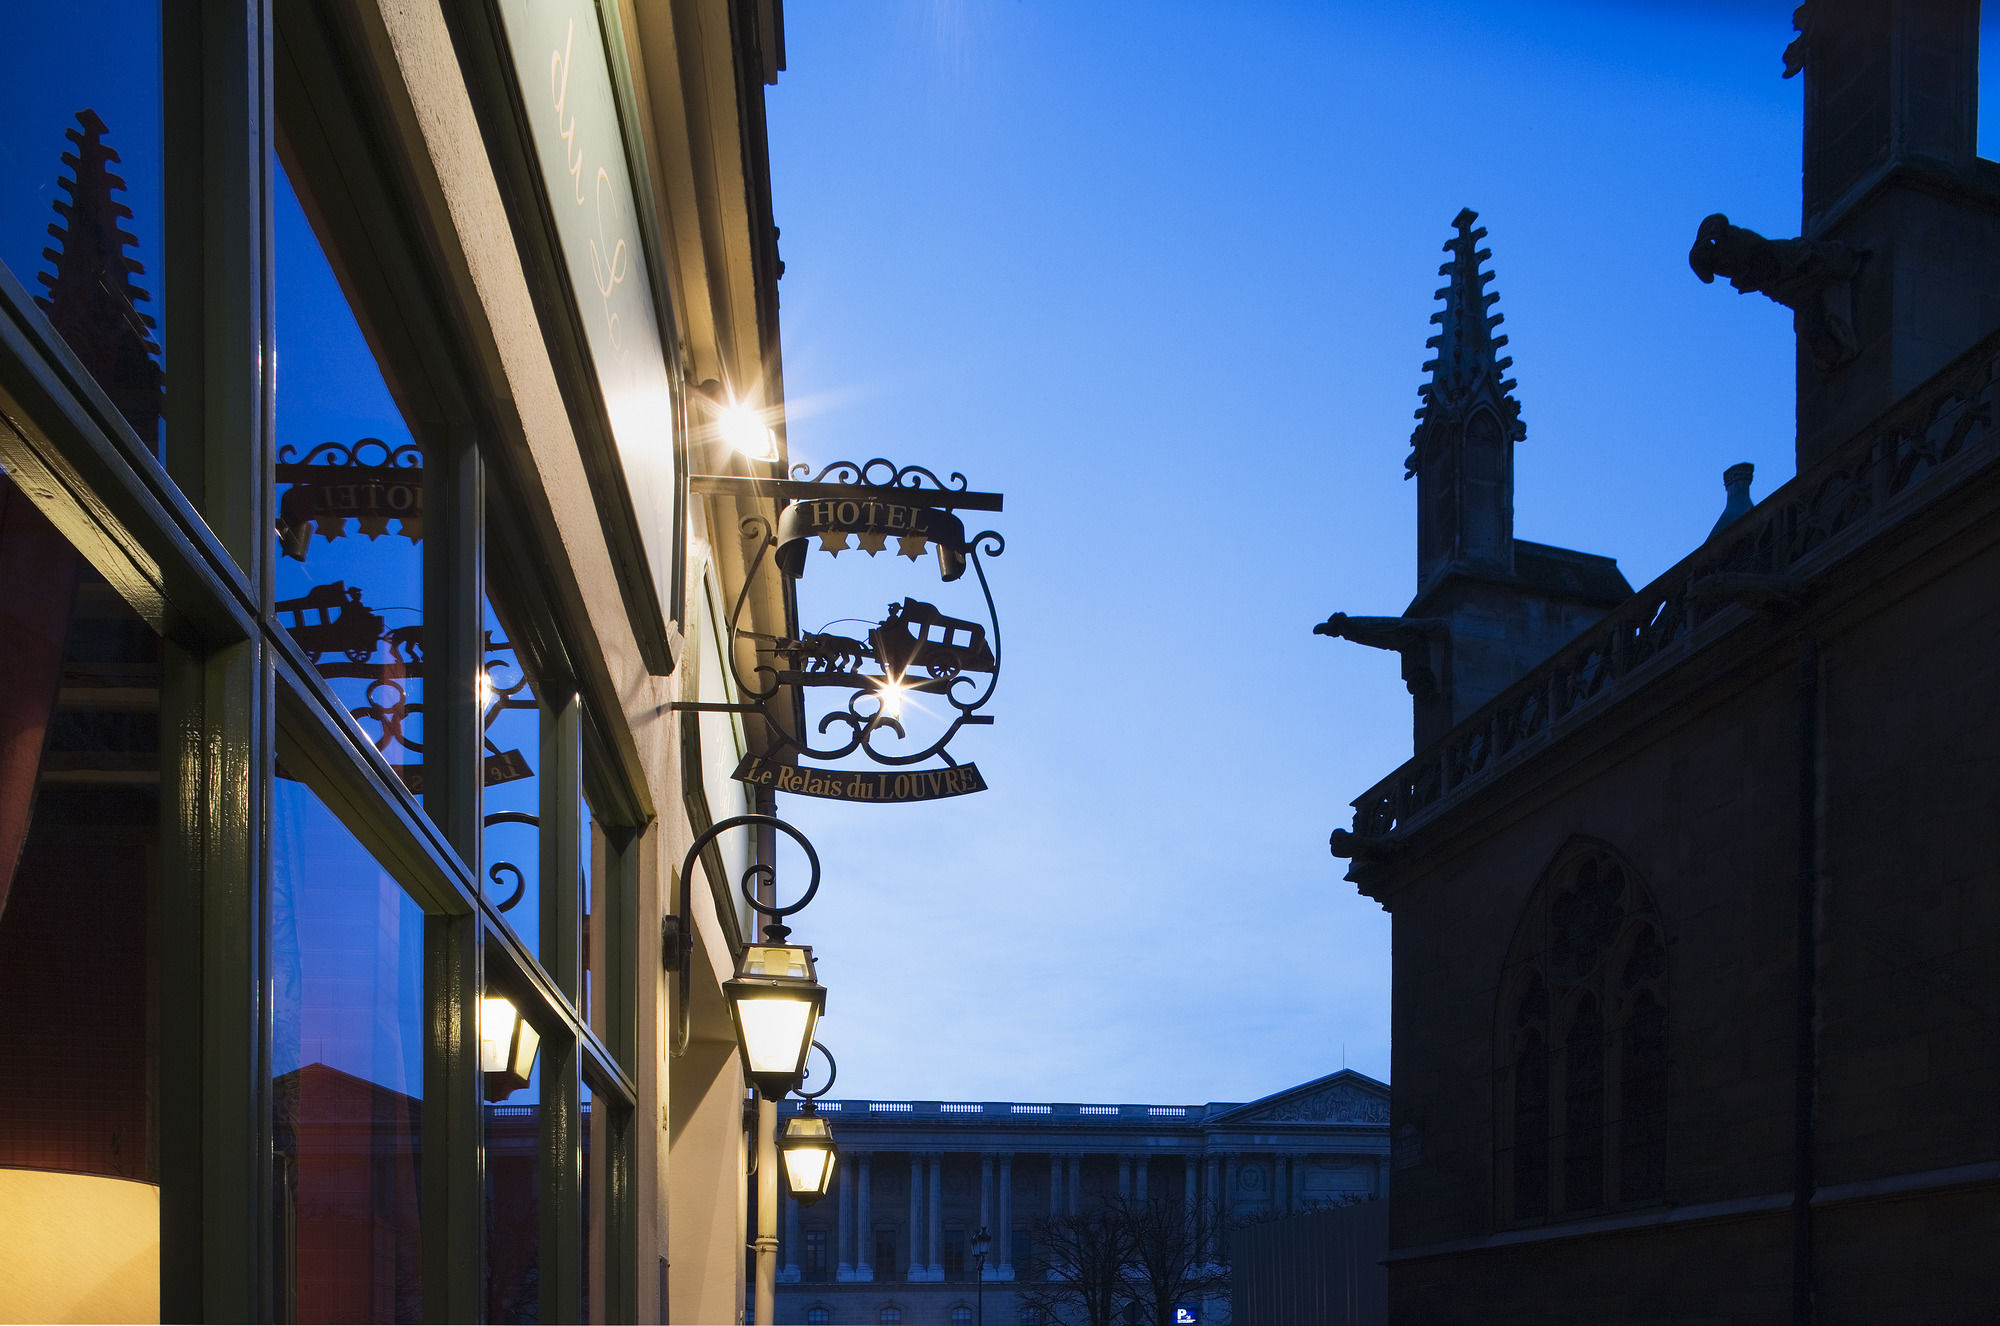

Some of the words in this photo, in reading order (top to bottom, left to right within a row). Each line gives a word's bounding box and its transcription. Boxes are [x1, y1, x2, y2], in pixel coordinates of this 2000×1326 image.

[810, 501, 928, 533] HOTEL
[743, 757, 772, 785] Le
[774, 764, 842, 797] Relais
[846, 773, 874, 799] du
[877, 766, 977, 800] LOUVRE
[1177, 1308, 1187, 1320] P
